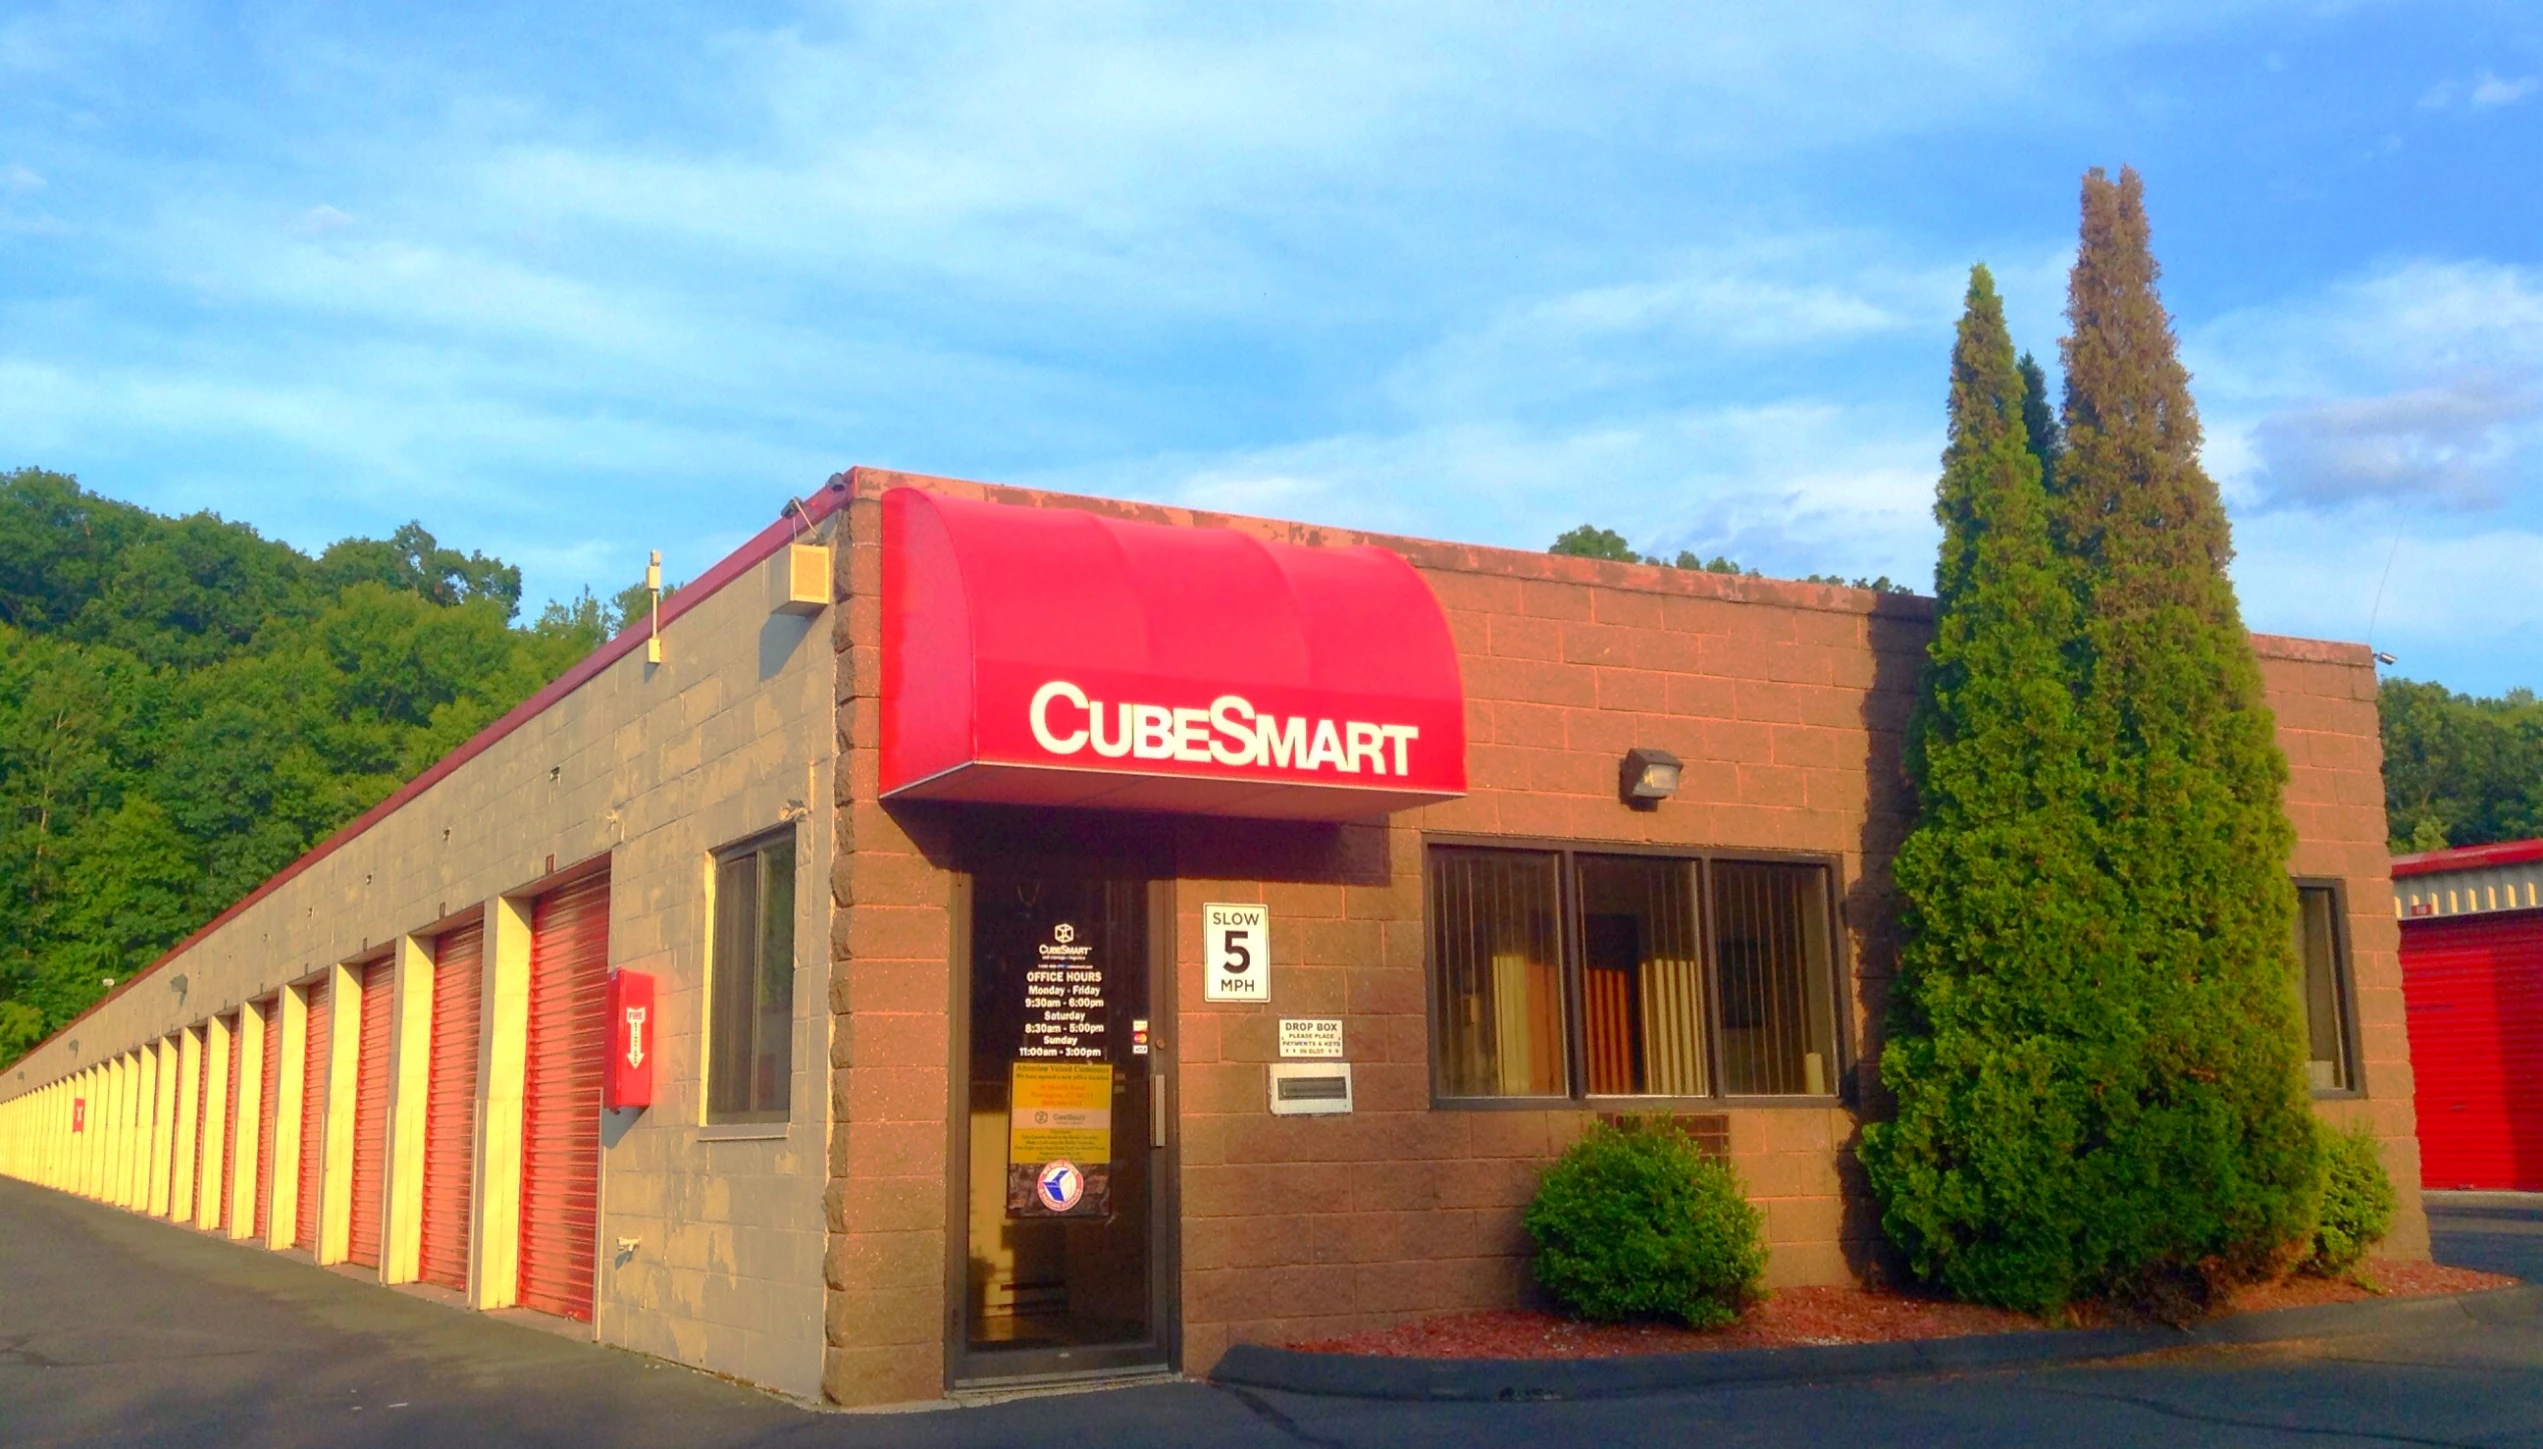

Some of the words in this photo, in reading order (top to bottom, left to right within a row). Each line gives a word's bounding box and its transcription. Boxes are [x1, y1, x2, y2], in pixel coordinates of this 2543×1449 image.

[1213, 912, 1259, 926] SLOW
[1223, 930, 1250, 974] 5
[1026, 971, 1064, 982] OFFICE
[1066, 971, 1102, 982] HOURS
[1028, 985, 1065, 997] Monday
[1072, 985, 1101, 997] Friday
[1221, 979, 1255, 992] MPH
[629, 1011, 642, 1020] FIRE
[1044, 1010, 1086, 1022] Saturday
[1069, 1023, 1104, 1034] 5:00pm
[1285, 1022, 1313, 1031] DROP
[1316, 1022, 1338, 1031] BOX
[1043, 1036, 1078, 1046] Sunday
[1019, 1047, 1058, 1057] 11:00am
[1065, 1047, 1101, 1058] 3:00pm
